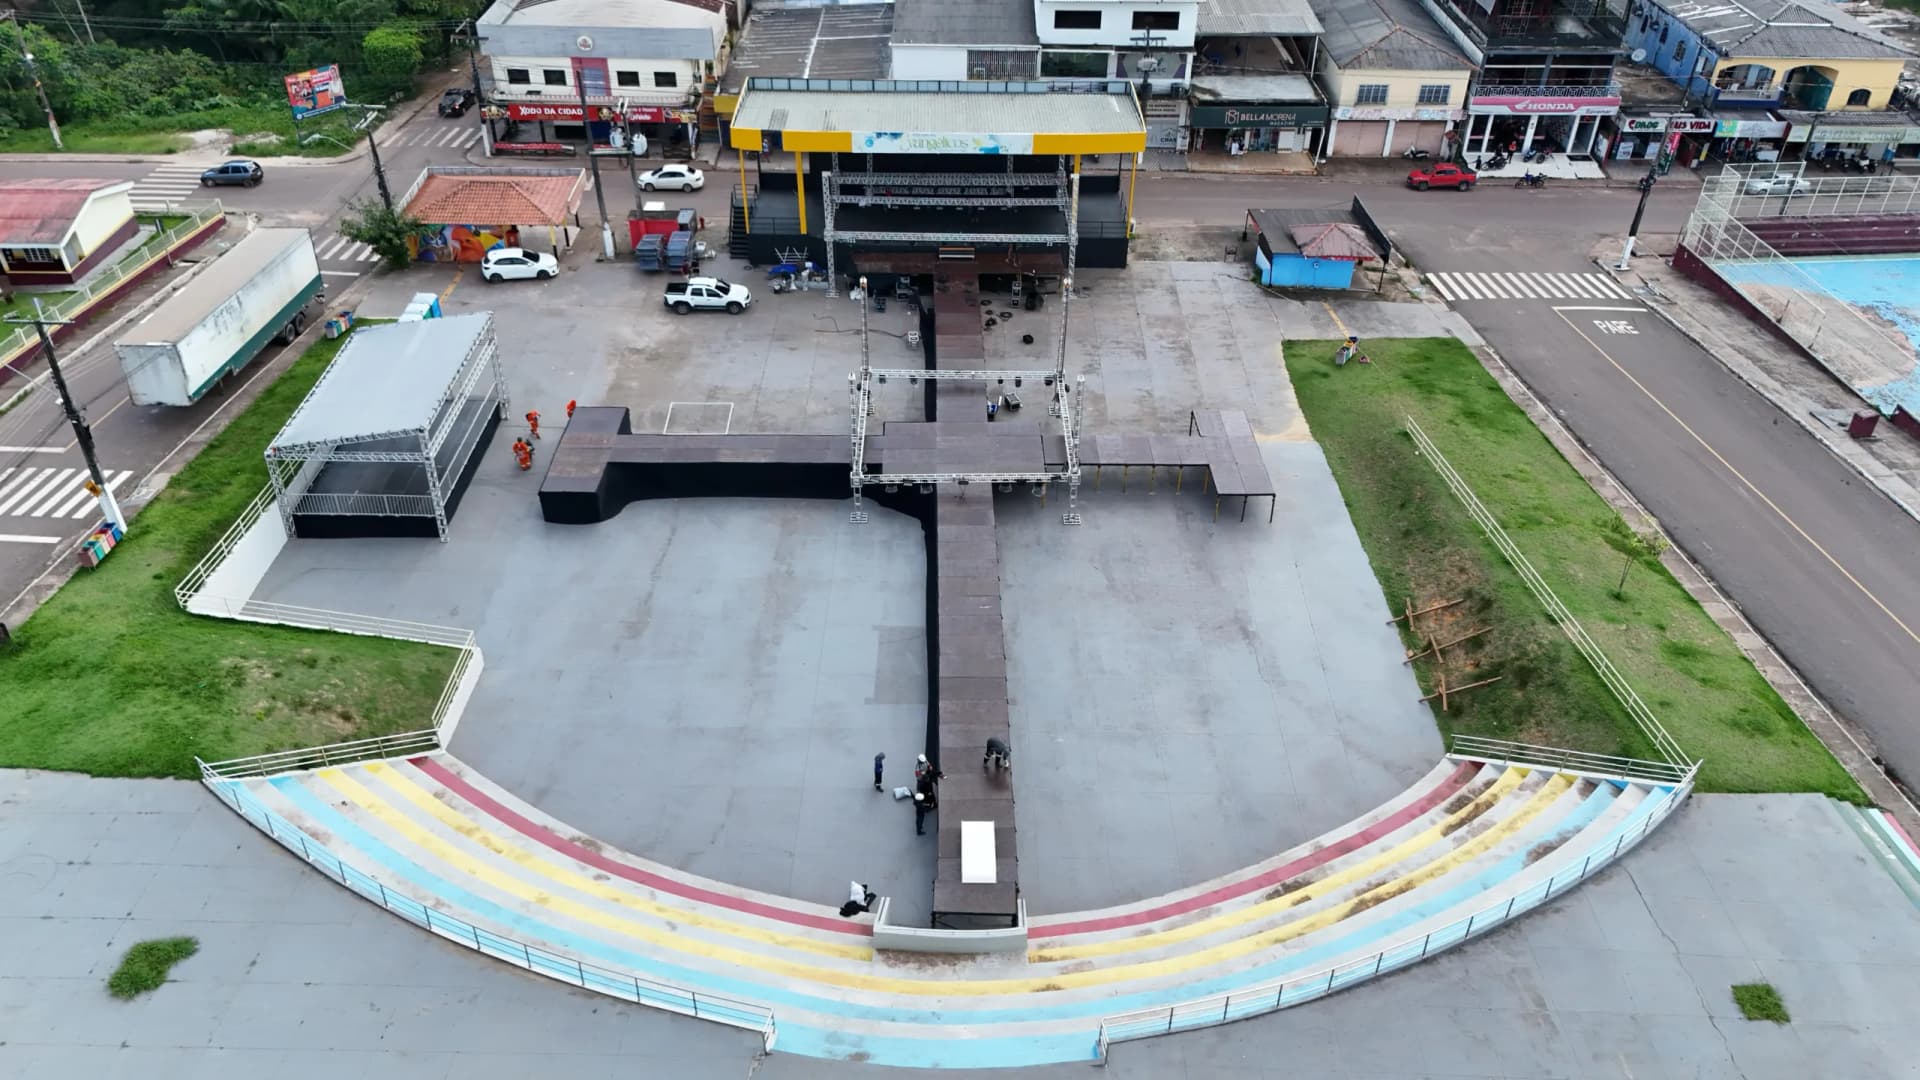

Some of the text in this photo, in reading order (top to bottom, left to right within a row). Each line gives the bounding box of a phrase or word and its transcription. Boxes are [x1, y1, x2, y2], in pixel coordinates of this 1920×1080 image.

[543, 107, 556, 115] DA
[557, 107, 585, 115] CIDAD
[1240, 113, 1297, 121] BELLA MORENA
[1690, 121, 1711, 130] VIDA
[1592, 320, 1640, 334] PARE
